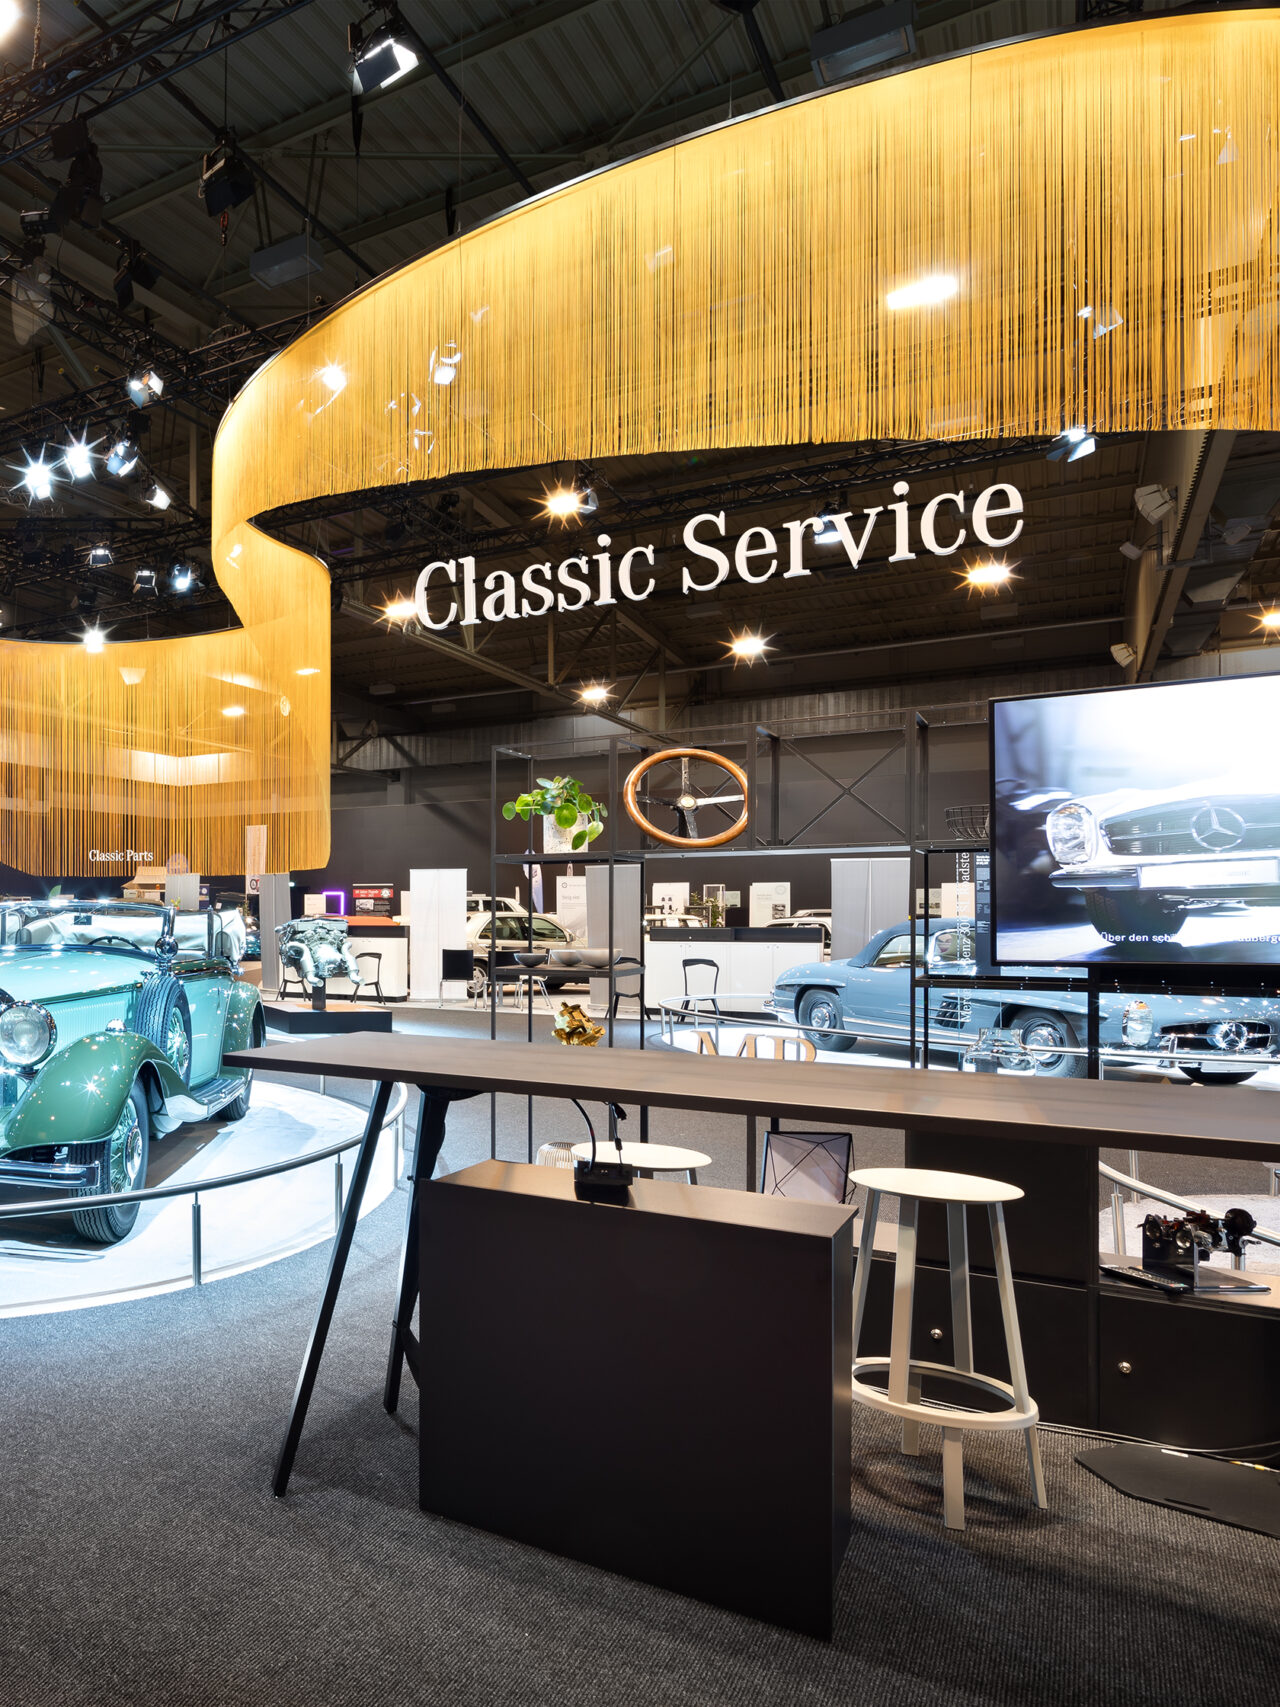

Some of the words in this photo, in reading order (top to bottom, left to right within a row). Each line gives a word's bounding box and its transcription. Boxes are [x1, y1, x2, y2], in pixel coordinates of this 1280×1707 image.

[414, 533, 656, 631] Classic
[681, 480, 1025, 595] Service
[88, 849, 125, 862] Classic
[126, 849, 154, 862] Parts
[959, 852, 971, 895] Roadste
[1100, 931, 1126, 942] Über
[1128, 932, 1149, 942] den
